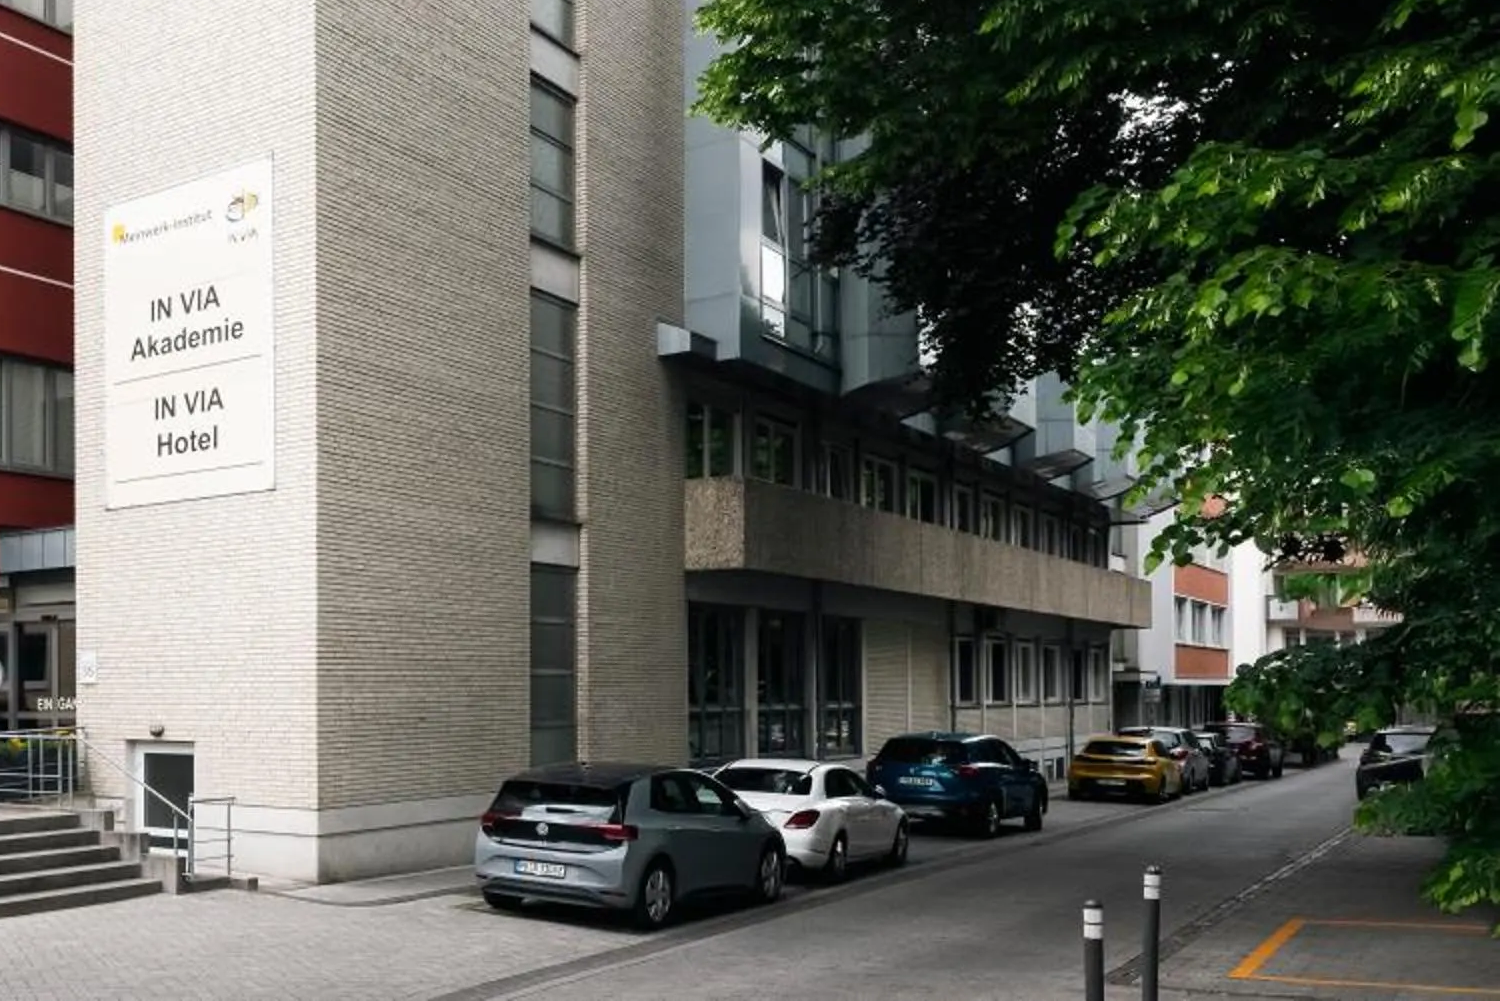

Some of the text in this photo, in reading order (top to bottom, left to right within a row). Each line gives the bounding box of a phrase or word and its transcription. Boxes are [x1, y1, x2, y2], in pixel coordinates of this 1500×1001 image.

[150, 285, 221, 323] IN VIA
[130, 317, 244, 361] Akademie
[154, 387, 224, 421] IN VIA
[156, 425, 218, 457] Hotel
